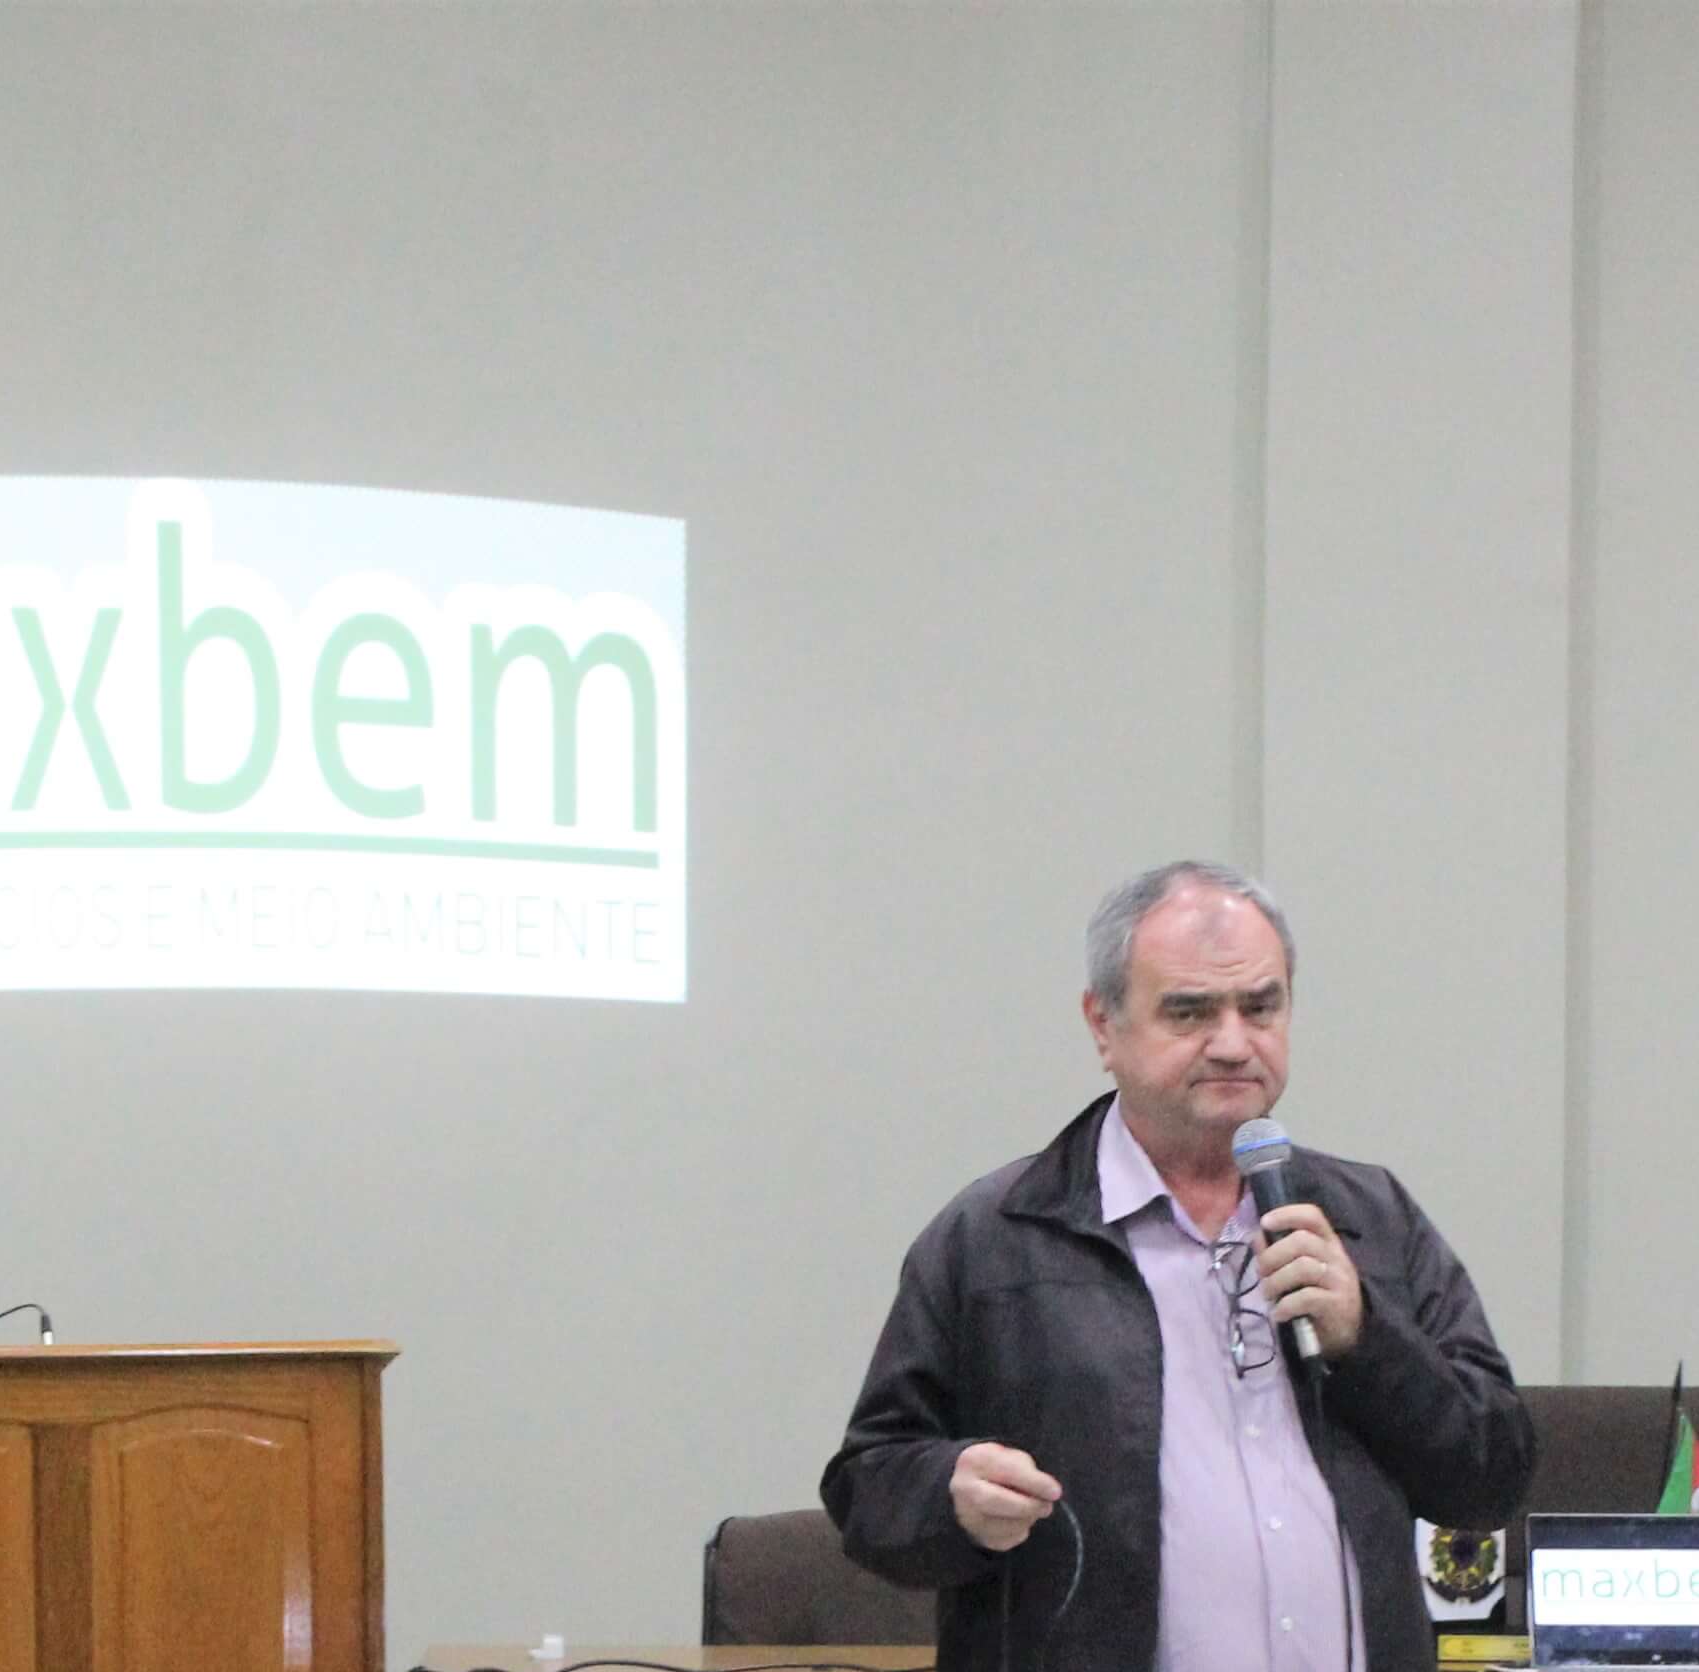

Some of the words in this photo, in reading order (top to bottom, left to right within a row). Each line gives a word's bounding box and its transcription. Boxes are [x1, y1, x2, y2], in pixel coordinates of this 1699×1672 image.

[146, 883, 173, 953] E
[195, 883, 340, 953] MEIO
[363, 888, 661, 965] AMBIENTE
